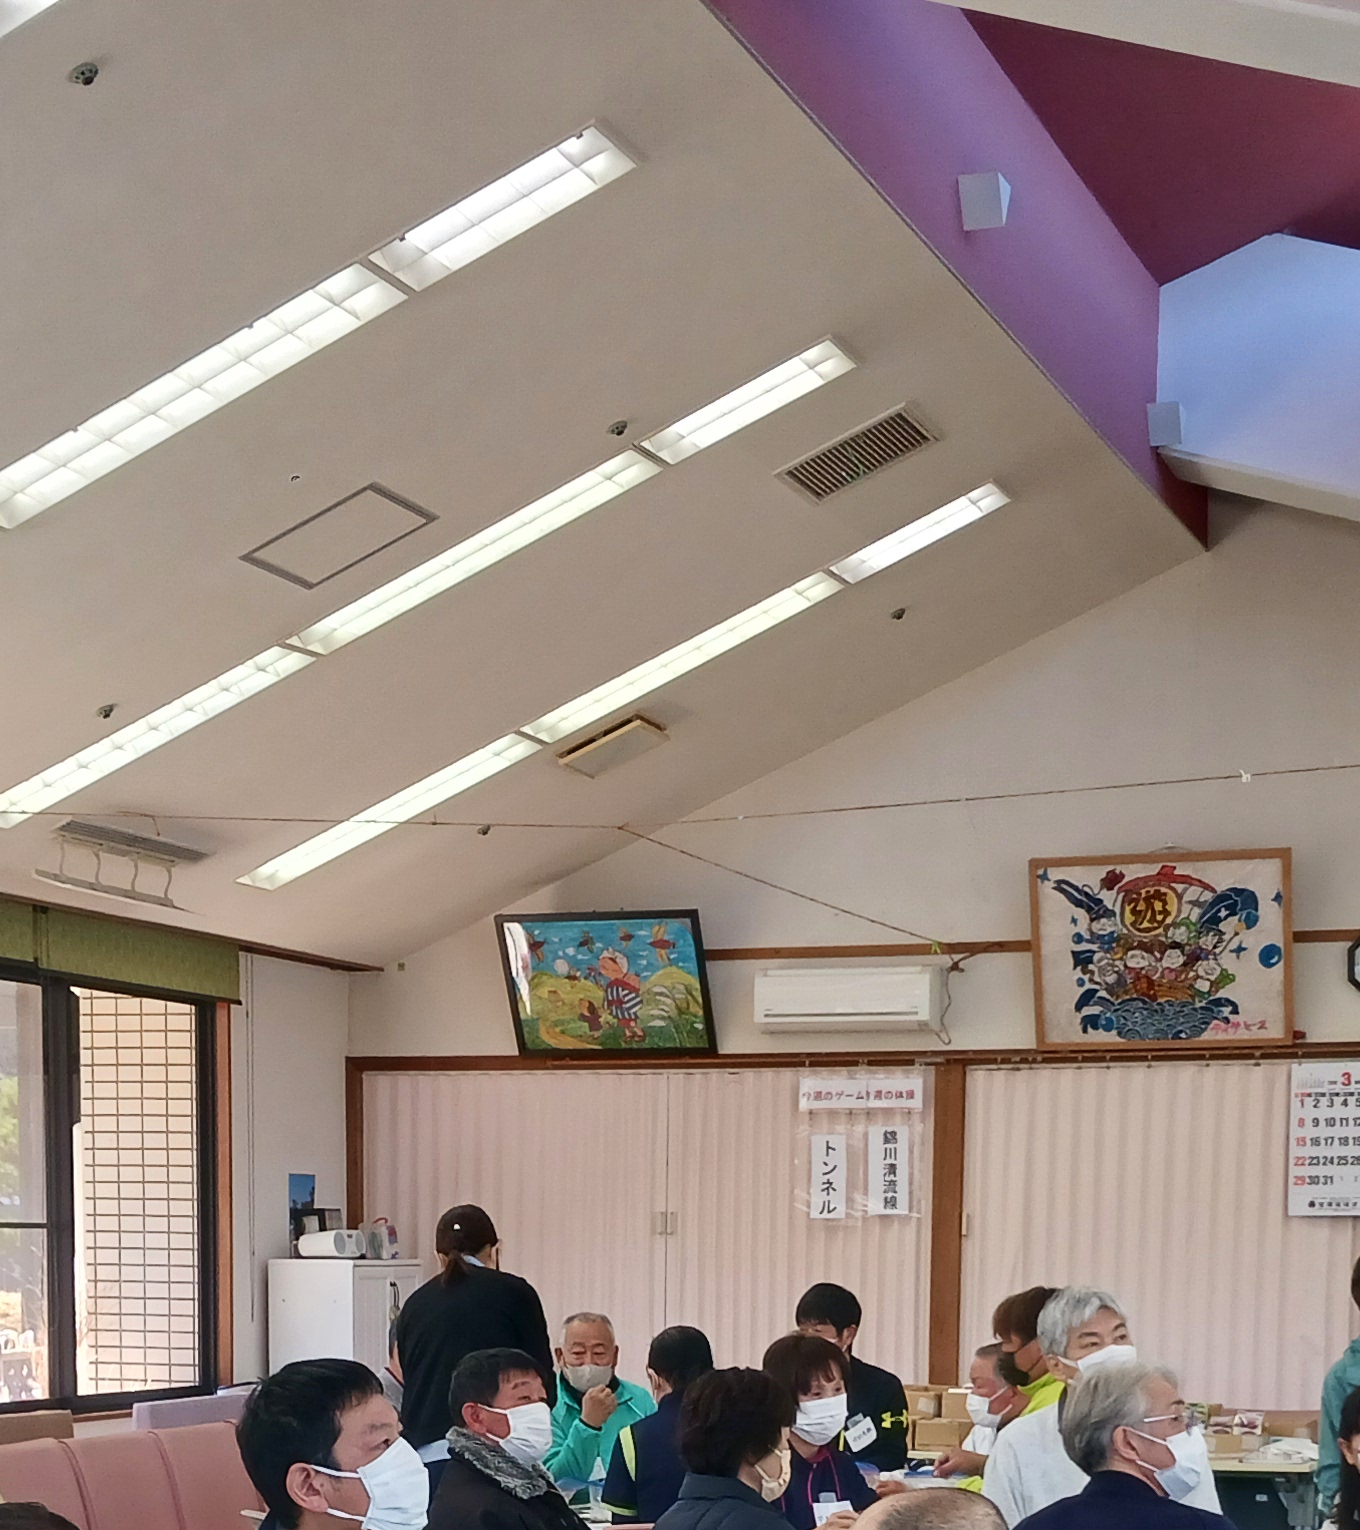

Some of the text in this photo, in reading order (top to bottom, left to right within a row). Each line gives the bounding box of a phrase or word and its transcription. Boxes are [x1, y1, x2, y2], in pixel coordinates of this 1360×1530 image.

[1341, 1072, 1352, 1086] 3
[1299, 1098, 1304, 1108] 1
[1312, 1098, 1320, 1108] 2
[1326, 1098, 1334, 1108] 3
[1340, 1098, 1349, 1108] 4
[1298, 1117, 1305, 1128] 8
[1312, 1117, 1319, 1127] 9
[1324, 1117, 1336, 1127] 10
[1339, 1117, 1349, 1127] 11
[1295, 1136, 1306, 1147] 15
[1309, 1136, 1321, 1146] 16
[1323, 1136, 1335, 1146] 17
[1338, 1136, 1349, 1146] 18
[1293, 1156, 1306, 1166] 22
[1308, 1156, 1320, 1166] 23
[1322, 1156, 1334, 1166] 24
[1336, 1155, 1348, 1165] 25
[819, 1140, 838, 1214] トンネル
[1293, 1175, 1306, 1185] 29
[1307, 1175, 1320, 1185] 30
[1321, 1175, 1334, 1185] 31
